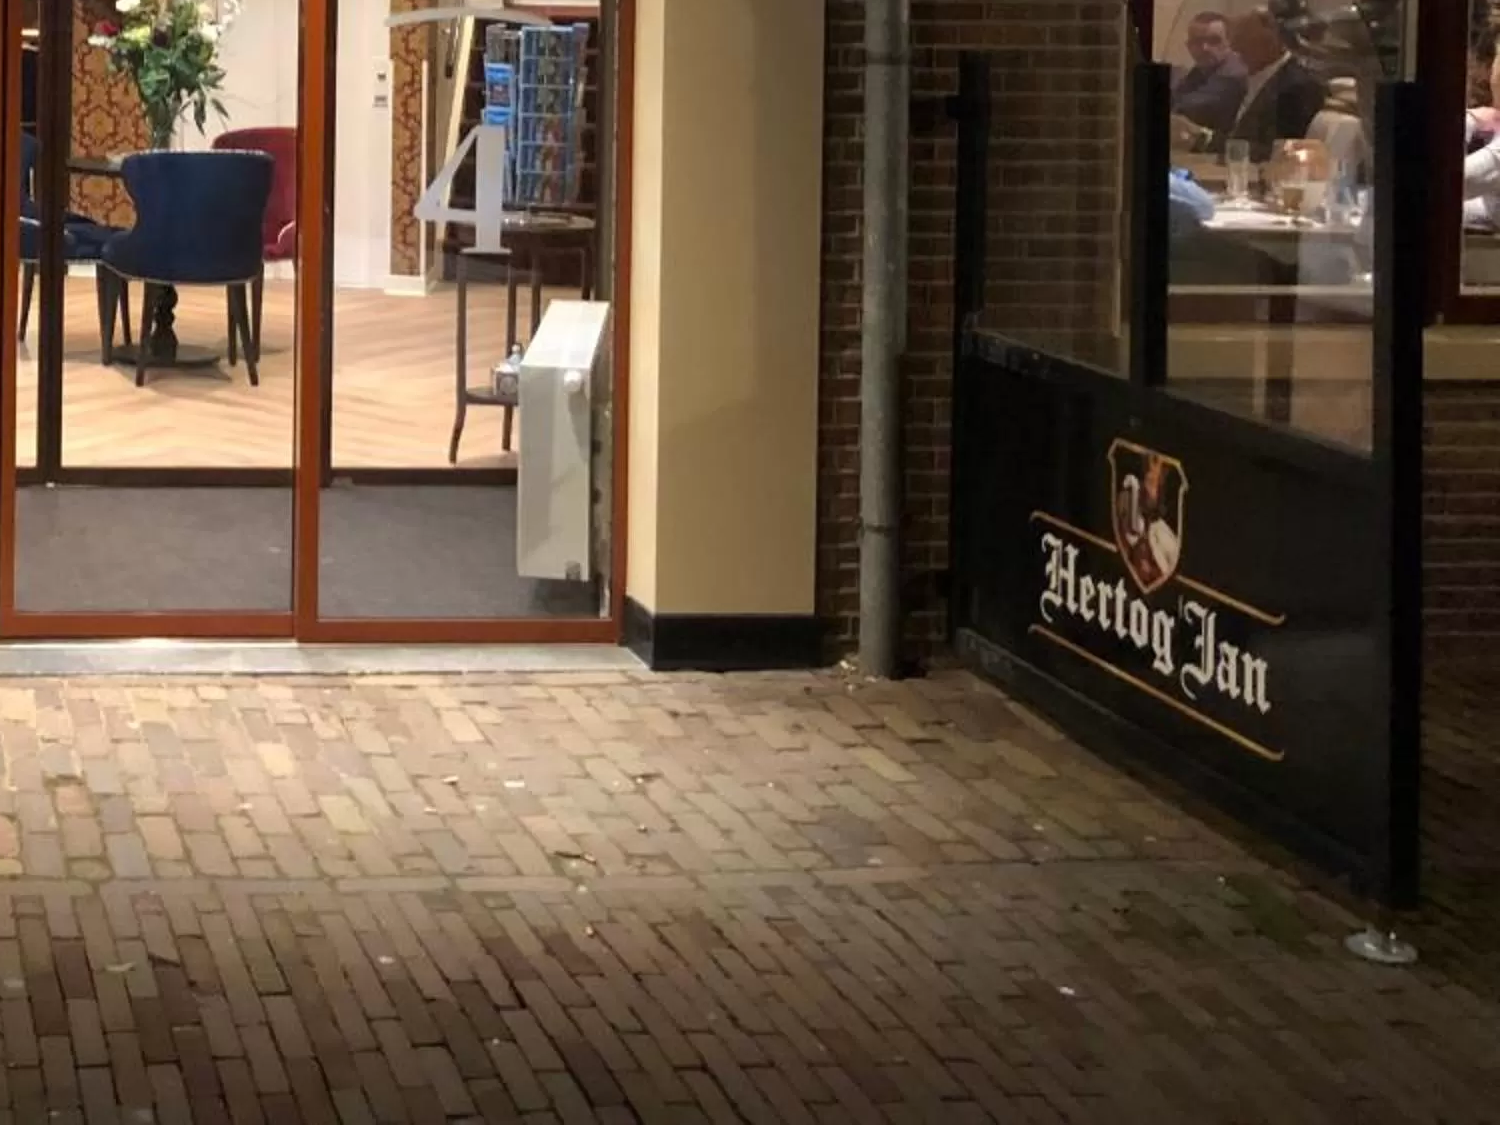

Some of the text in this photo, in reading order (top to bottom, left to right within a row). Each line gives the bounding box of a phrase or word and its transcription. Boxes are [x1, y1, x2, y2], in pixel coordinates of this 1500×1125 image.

[413, 124, 518, 255] 4
[1040, 531, 1272, 715] Hertog Jan
